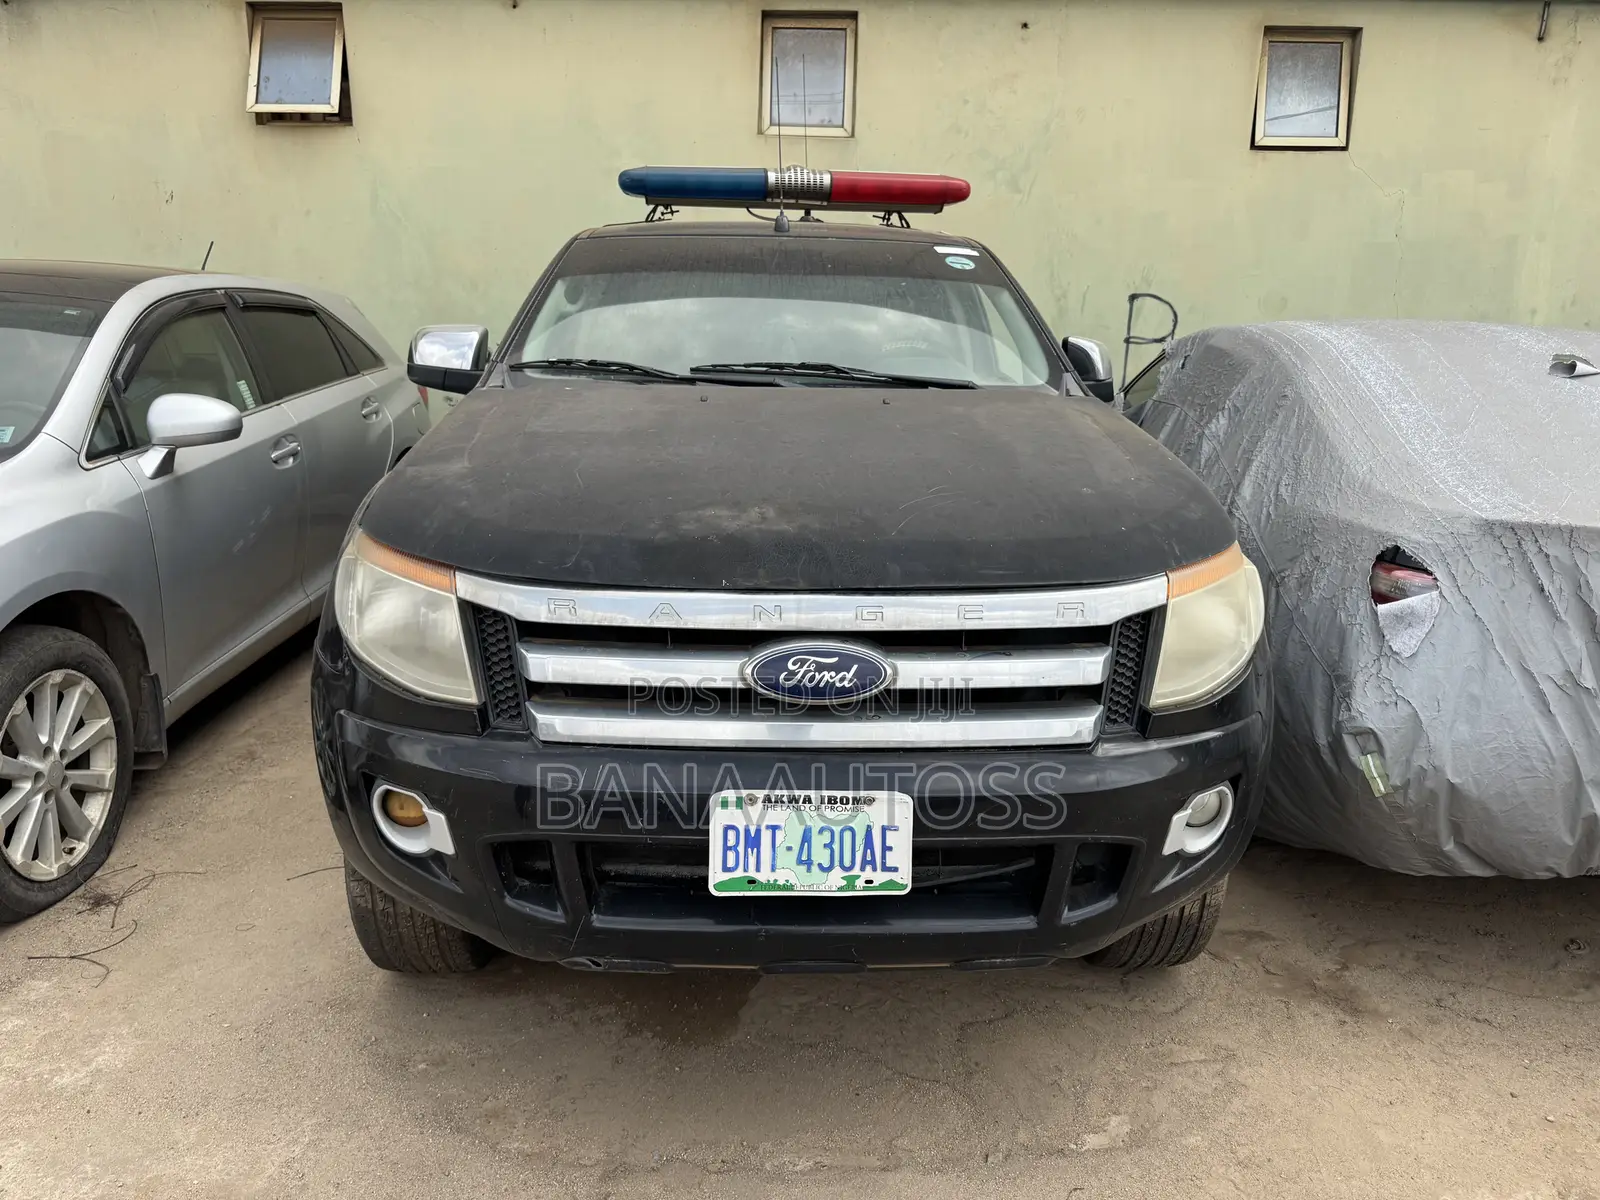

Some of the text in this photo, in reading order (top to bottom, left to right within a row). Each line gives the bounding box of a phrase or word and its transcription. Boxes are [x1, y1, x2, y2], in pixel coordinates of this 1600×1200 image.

[547, 597, 1085, 622] RANGER
[779, 655, 859, 688] Ford
[761, 794, 868, 806] AKWA IBOM
[780, 804, 806, 812] LAND
[721, 824, 899, 873] BMT-430AE
